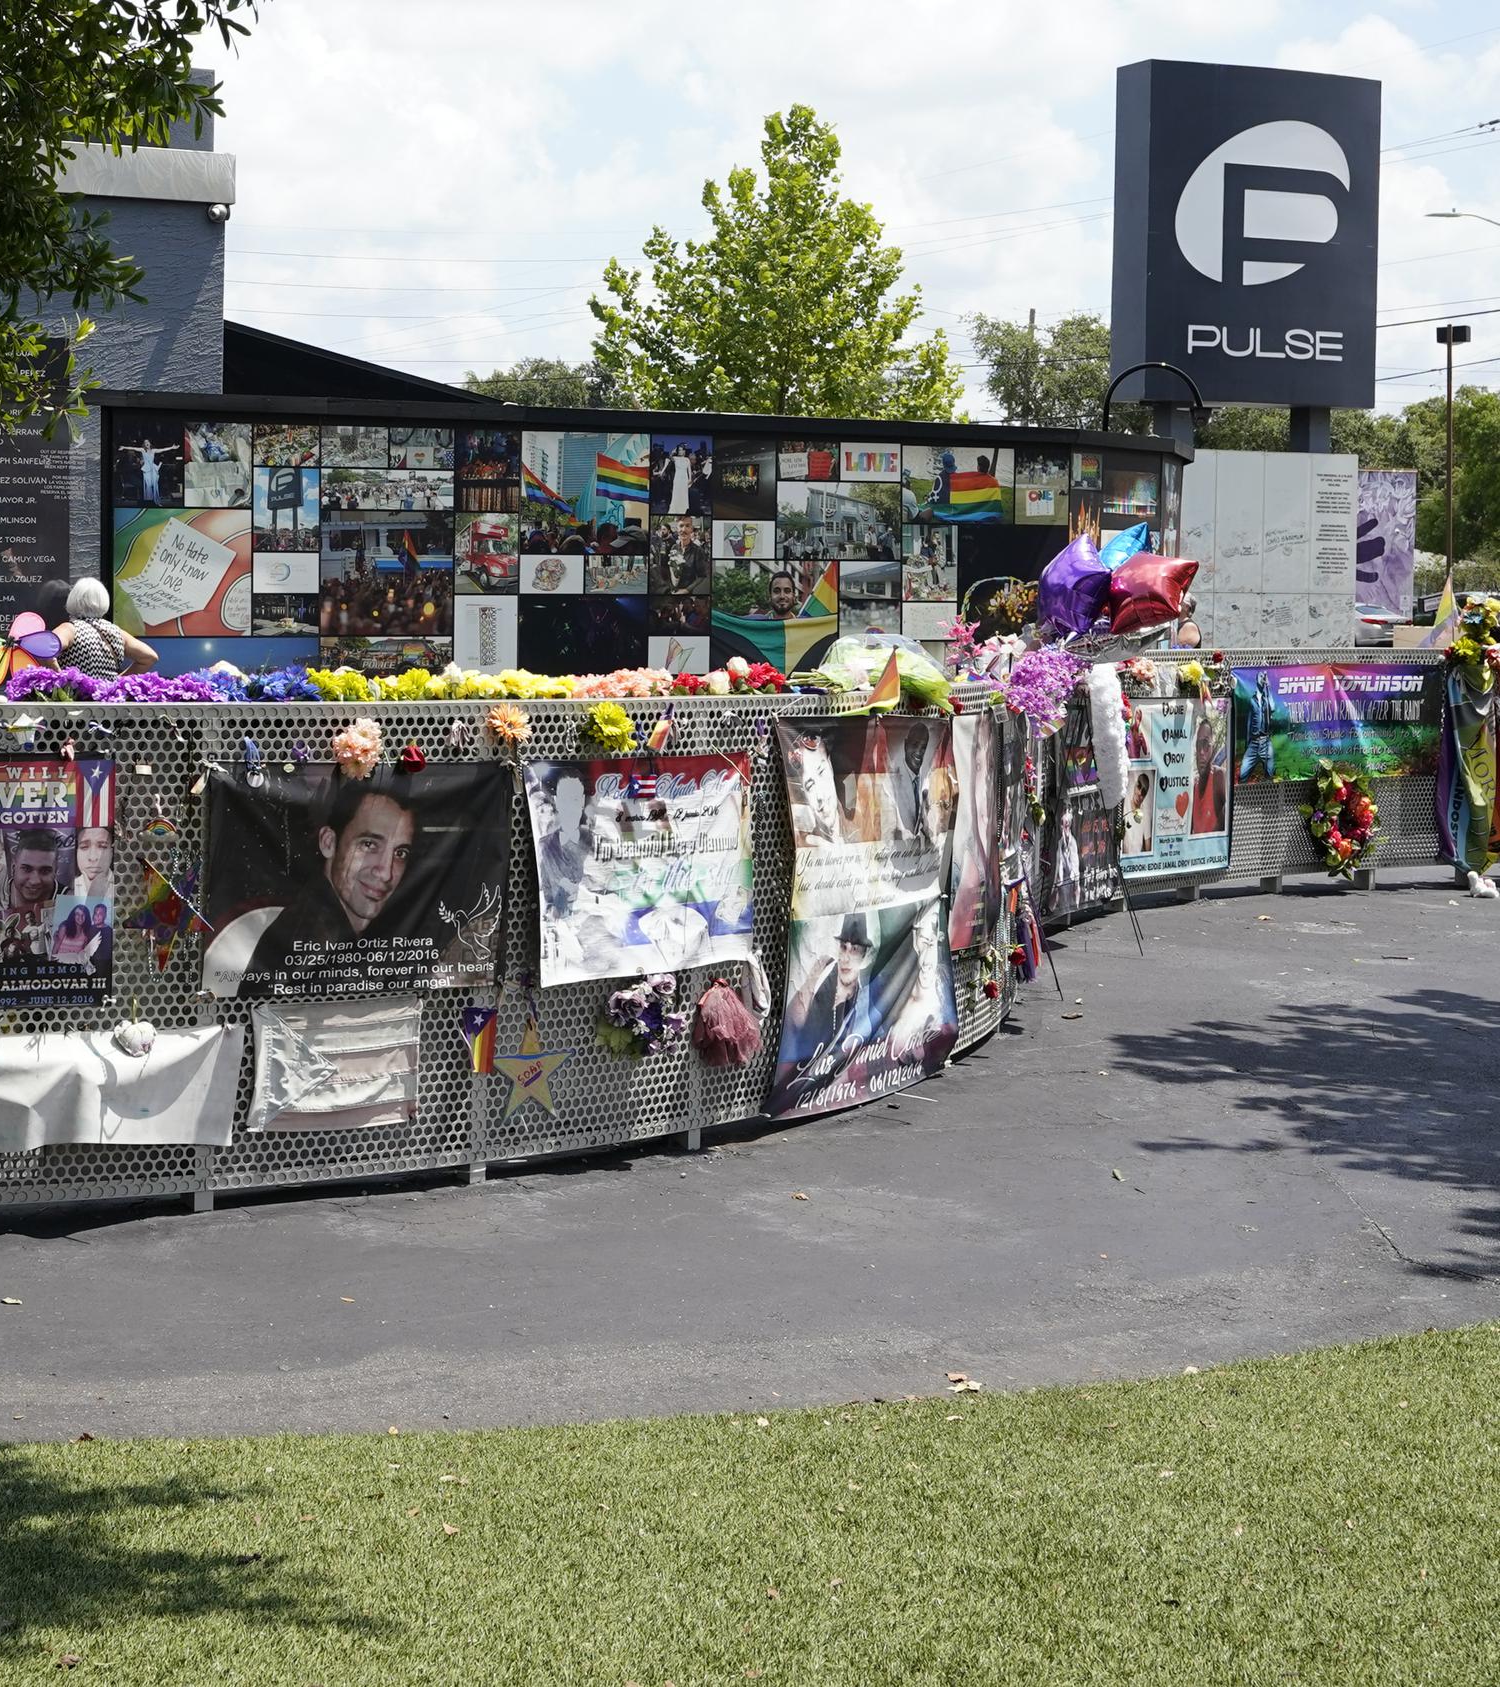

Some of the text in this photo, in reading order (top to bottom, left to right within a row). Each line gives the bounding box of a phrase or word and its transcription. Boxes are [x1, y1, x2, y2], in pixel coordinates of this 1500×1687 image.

[1188, 324, 1344, 362] PULSE
[845, 452, 898, 472] LOVE
[172, 534, 209, 564] No Hate
[180, 560, 209, 581] know
[362, 660, 396, 669] POLICE
[1278, 675, 1325, 694] SHANE
[6, 766, 67, 779] WILL
[293, 937, 433, 951] Eric Ivan Ortiz Rivera
[285, 950, 439, 966] 03/25/1980-06/12/2016
[275, 970, 286, 981] in
[293, 970, 313, 981] our
[318, 967, 362, 979] minds,
[367, 965, 414, 976] forever
[417, 964, 427, 974] in
[432, 963, 453, 973] our
[0, 978, 88, 991] ALMODOVAR
[92, 978, 106, 989] III
[310, 983, 320, 993] in
[326, 980, 384, 995] paradise
[388, 979, 409, 989] our
[28, 997, 53, 1005] JUNE
[786, 1042, 836, 1090] Luis
[834, 1033, 892, 1077] Daniel
[795, 1061, 922, 1110] 12/8/1976 06/12/2016
